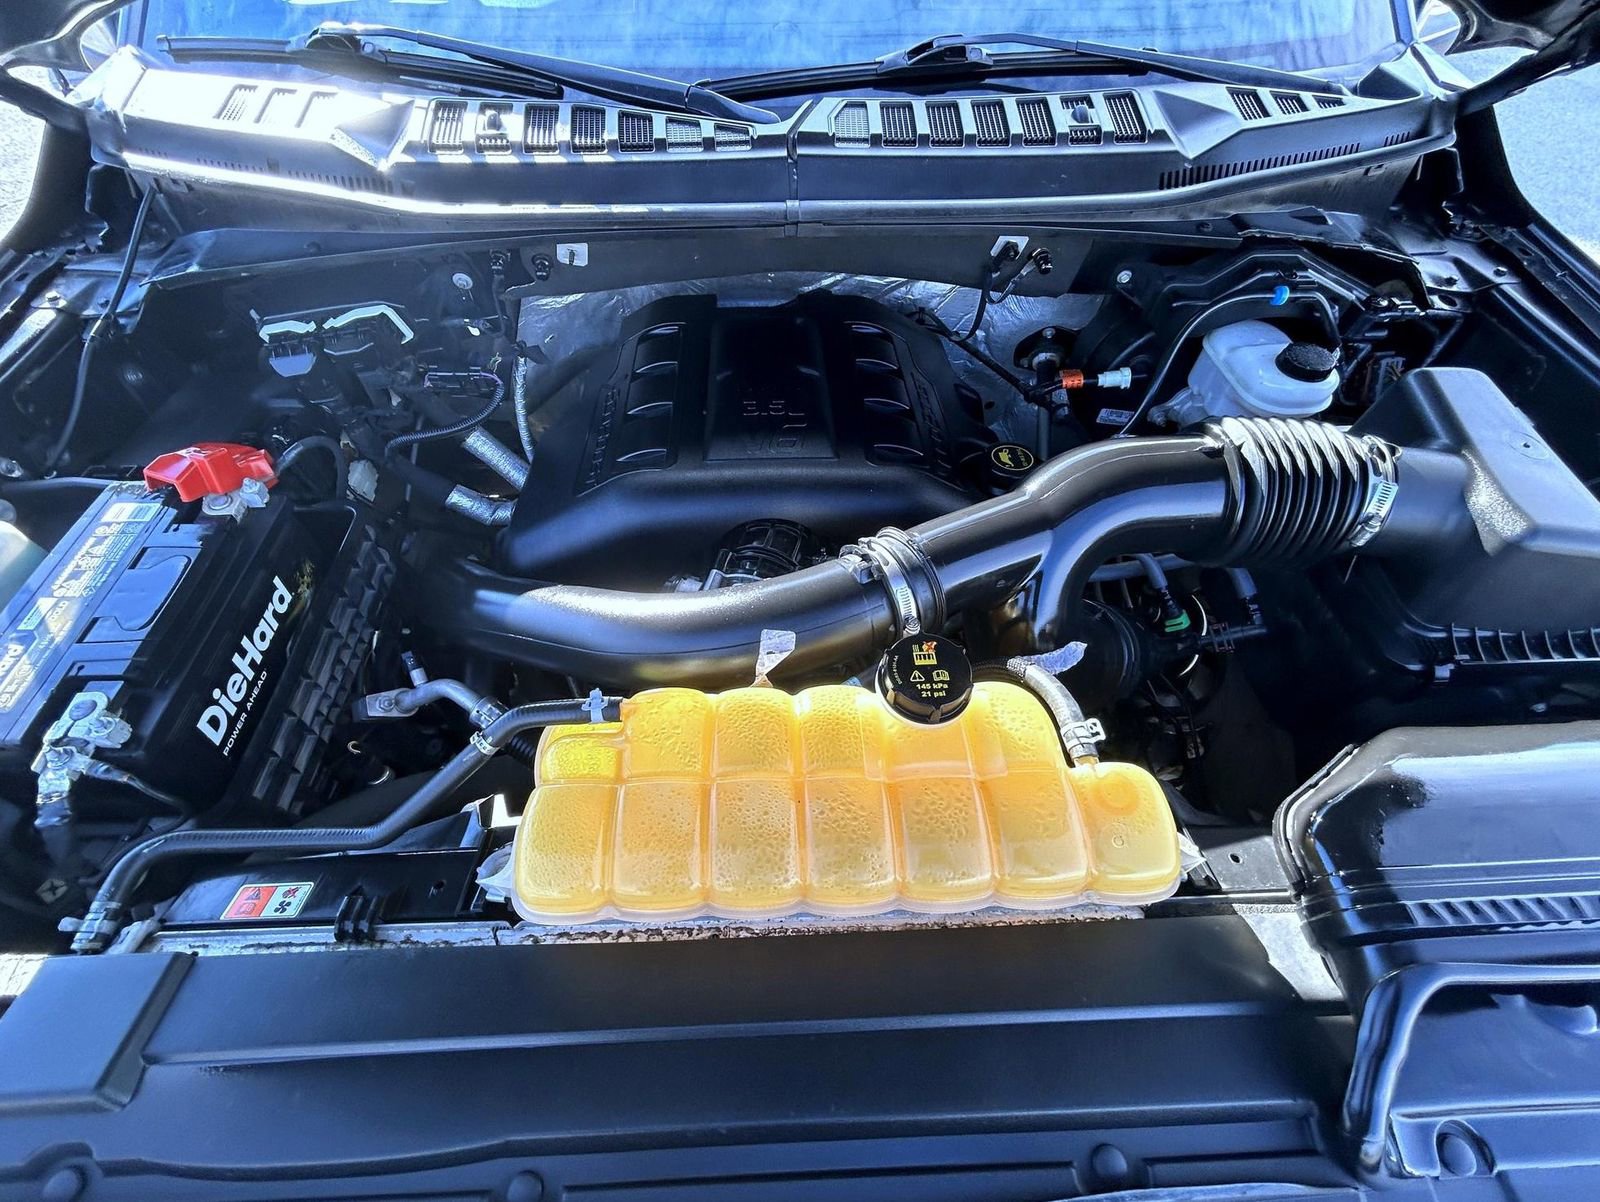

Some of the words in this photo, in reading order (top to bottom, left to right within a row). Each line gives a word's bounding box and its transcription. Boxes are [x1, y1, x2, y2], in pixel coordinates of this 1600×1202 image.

[196, 575, 293, 746] DieHard
[934, 690, 946, 698] psi
[222, 714, 248, 757] POWER
[246, 671, 267, 711] AHEAD
